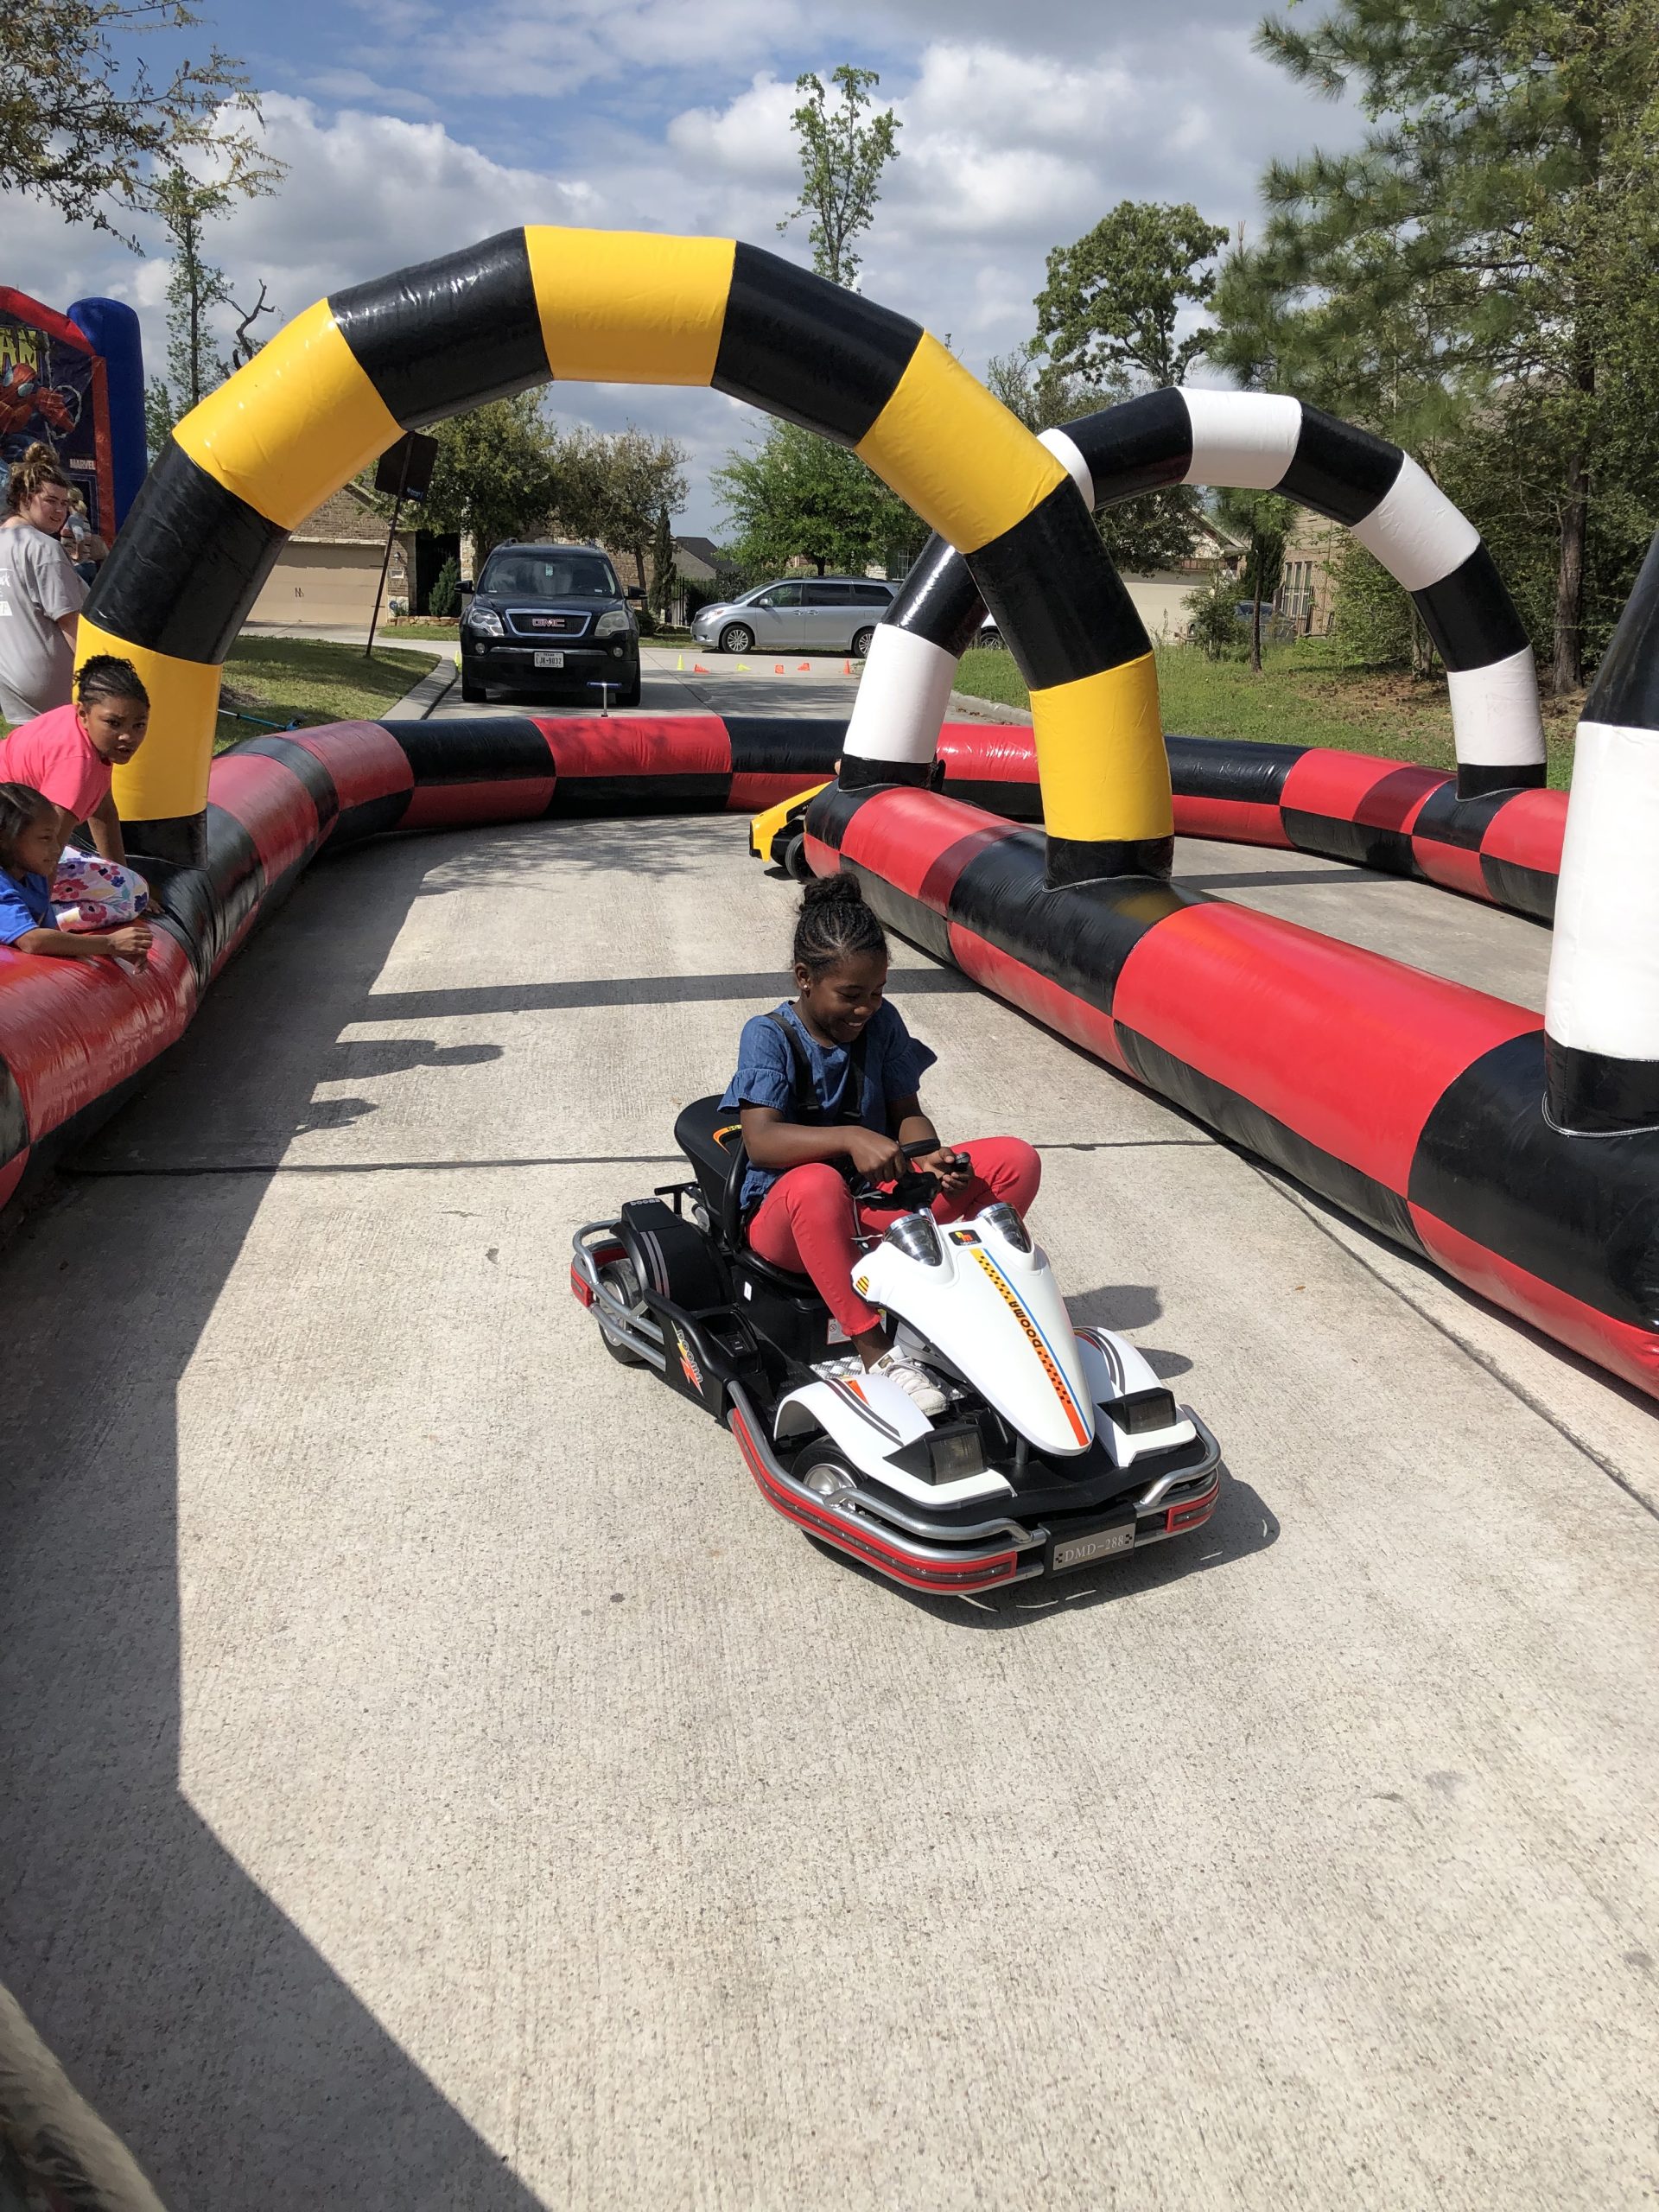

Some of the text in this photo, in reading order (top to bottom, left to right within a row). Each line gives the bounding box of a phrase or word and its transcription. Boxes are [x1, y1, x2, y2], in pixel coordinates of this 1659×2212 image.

[69, 458, 96, 470] MARVEL
[531, 618, 565, 627] GMC
[1008, 1300, 1044, 1348] DOOMA
[1065, 1535, 1124, 1562] DMD-288
